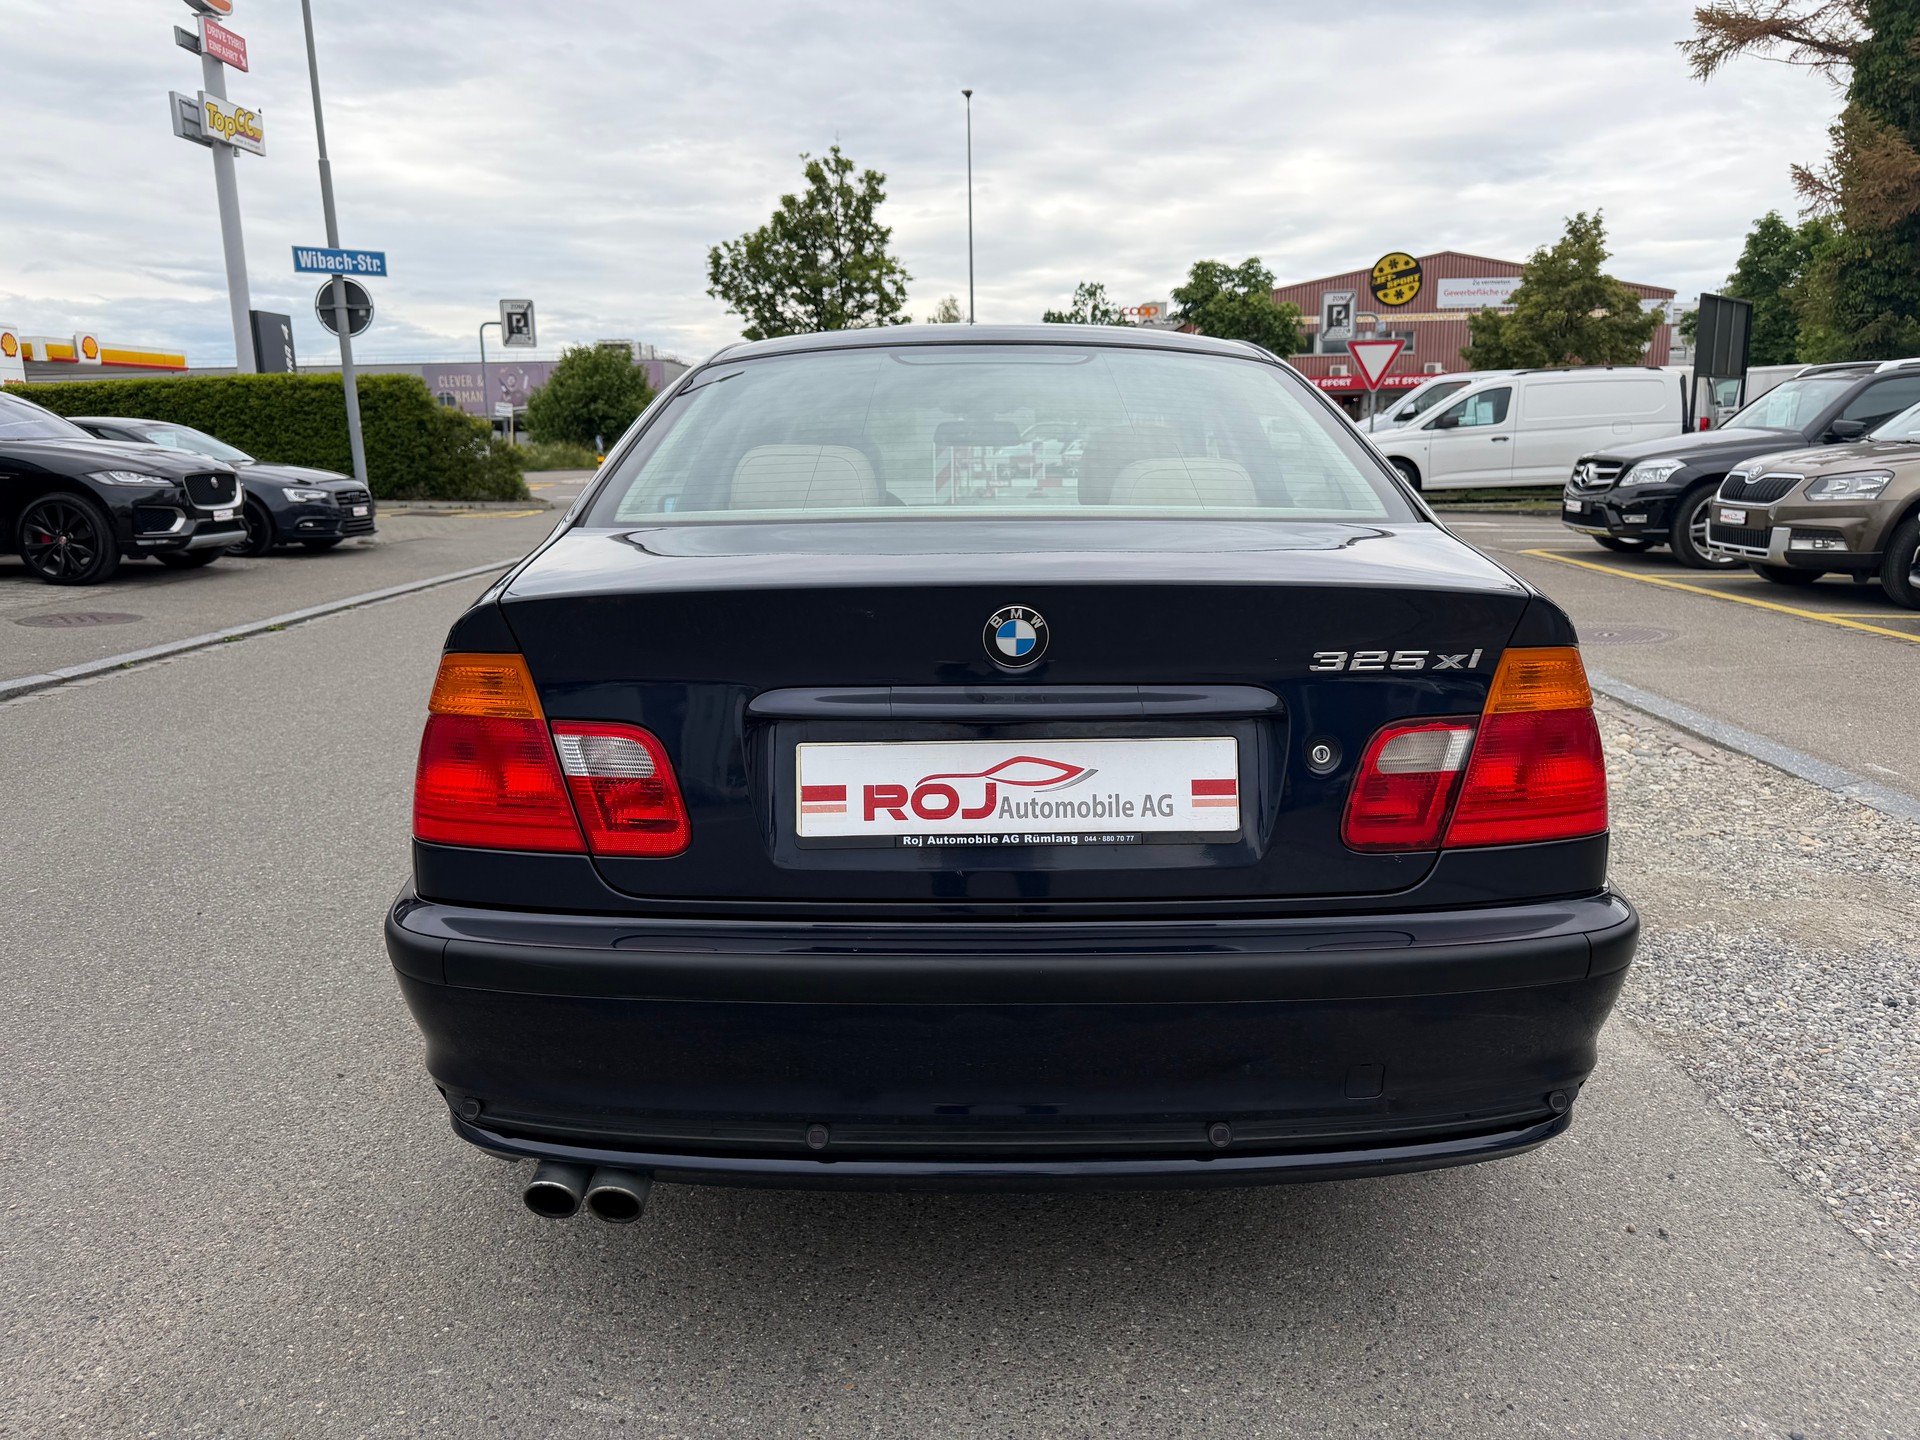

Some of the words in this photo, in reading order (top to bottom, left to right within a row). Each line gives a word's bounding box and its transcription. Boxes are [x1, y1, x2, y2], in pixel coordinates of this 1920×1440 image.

[206, 23, 227, 43] DRIVE
[226, 34, 244, 52] THRU
[205, 101, 255, 141] TopCC
[297, 250, 381, 272] Wibach-Str.
[438, 374, 473, 388] CLEVER
[1321, 378, 1352, 387] SPORT
[1384, 376, 1400, 385] JET
[989, 608, 1044, 629] BMW
[863, 782, 997, 822] ROJ
[998, 793, 1135, 819] Automobile
[1140, 793, 1175, 818] AG
[903, 835, 923, 847] Roj
[926, 834, 999, 845] Automobile
[1001, 834, 1020, 844] AG
[1024, 834, 1079, 845] Rümlang
